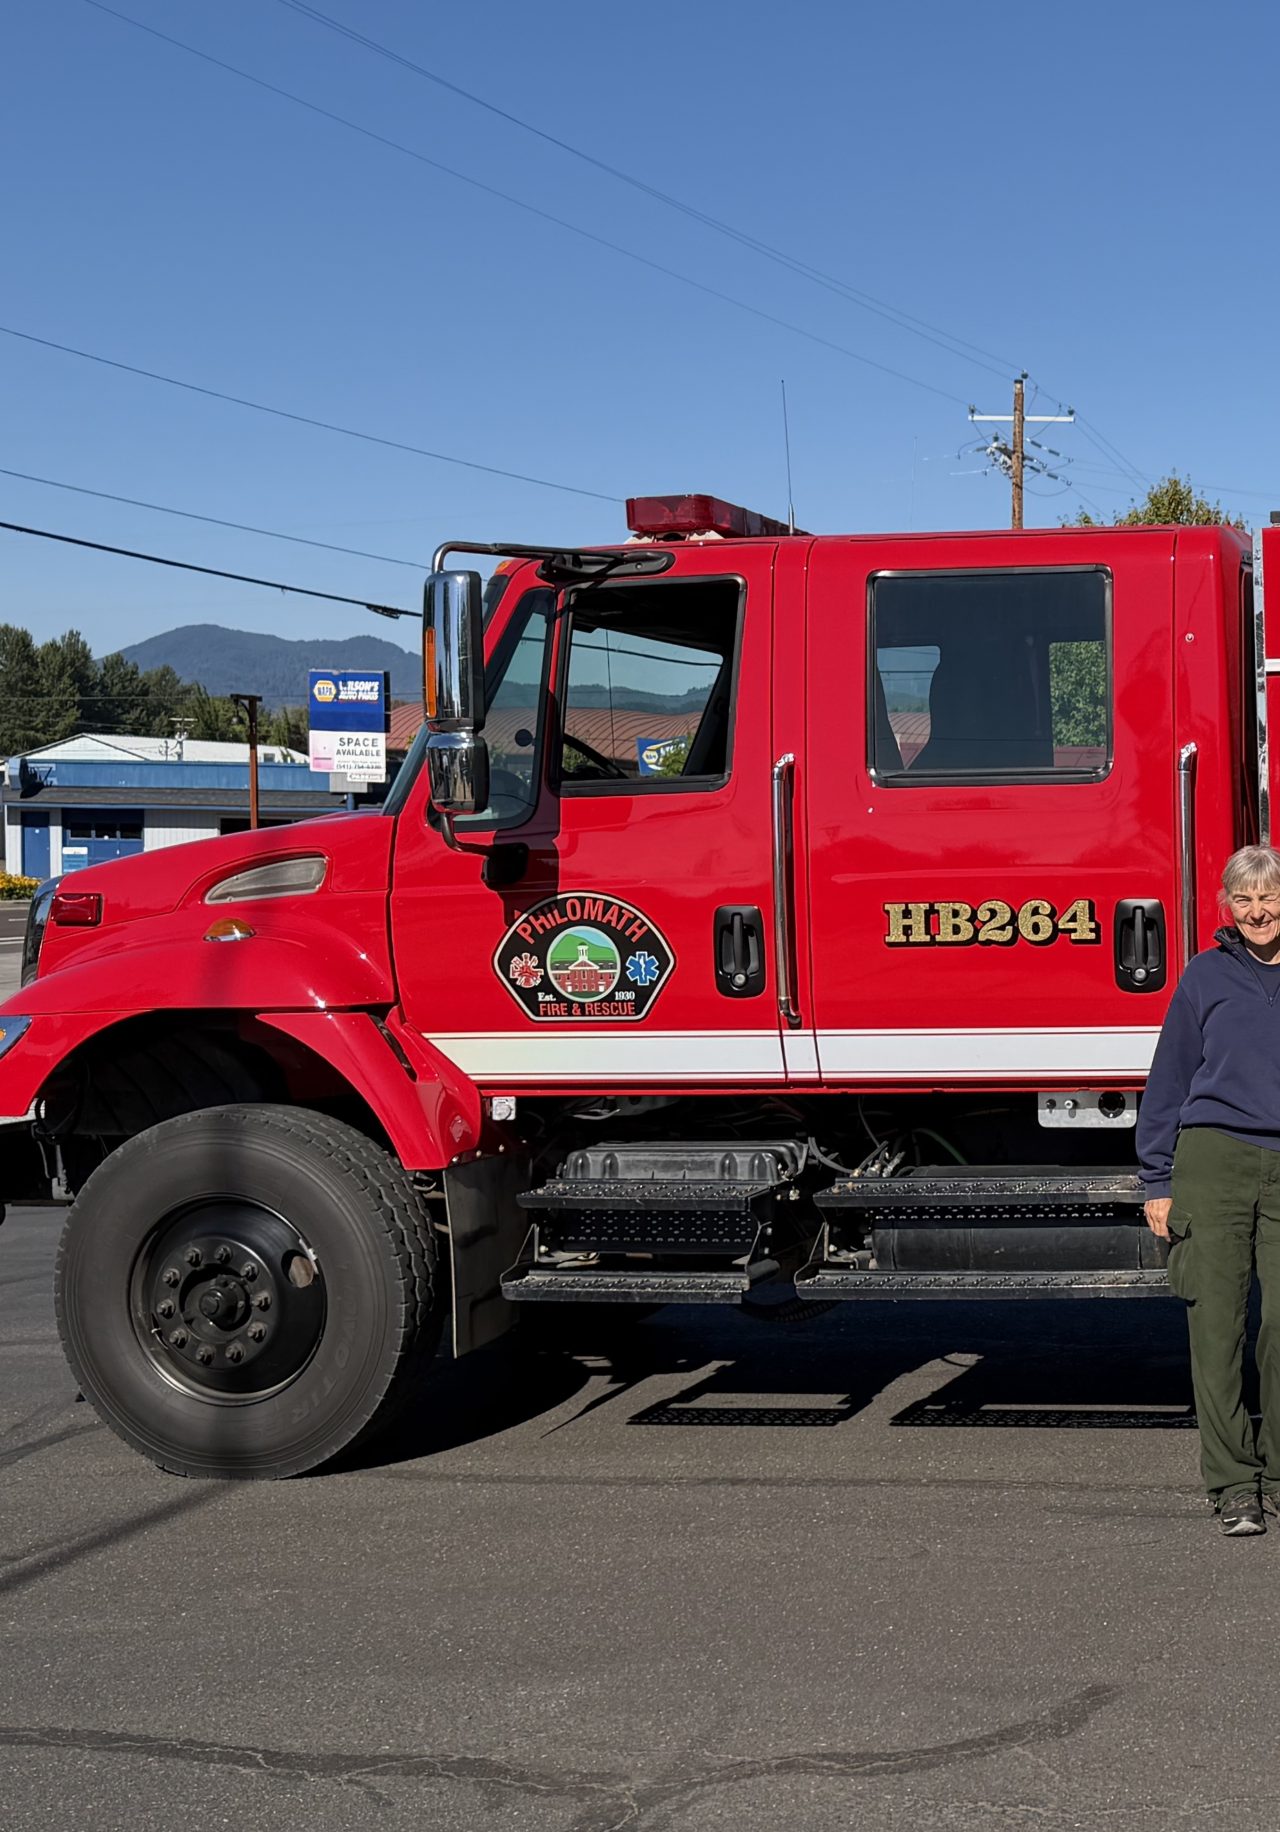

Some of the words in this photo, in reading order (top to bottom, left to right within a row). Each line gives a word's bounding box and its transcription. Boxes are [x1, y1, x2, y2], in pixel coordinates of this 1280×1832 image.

[338, 737, 379, 747] SPACE
[336, 749, 381, 757] AVAILABLE
[516, 898, 648, 945] PHILOMATH
[884, 900, 1098, 944] HB264
[537, 992, 556, 1001] Est.
[615, 992, 635, 1001] 1930
[539, 1003, 568, 1016] FIRE
[572, 1003, 581, 1016] &
[585, 1002, 635, 1016] RESCUE
